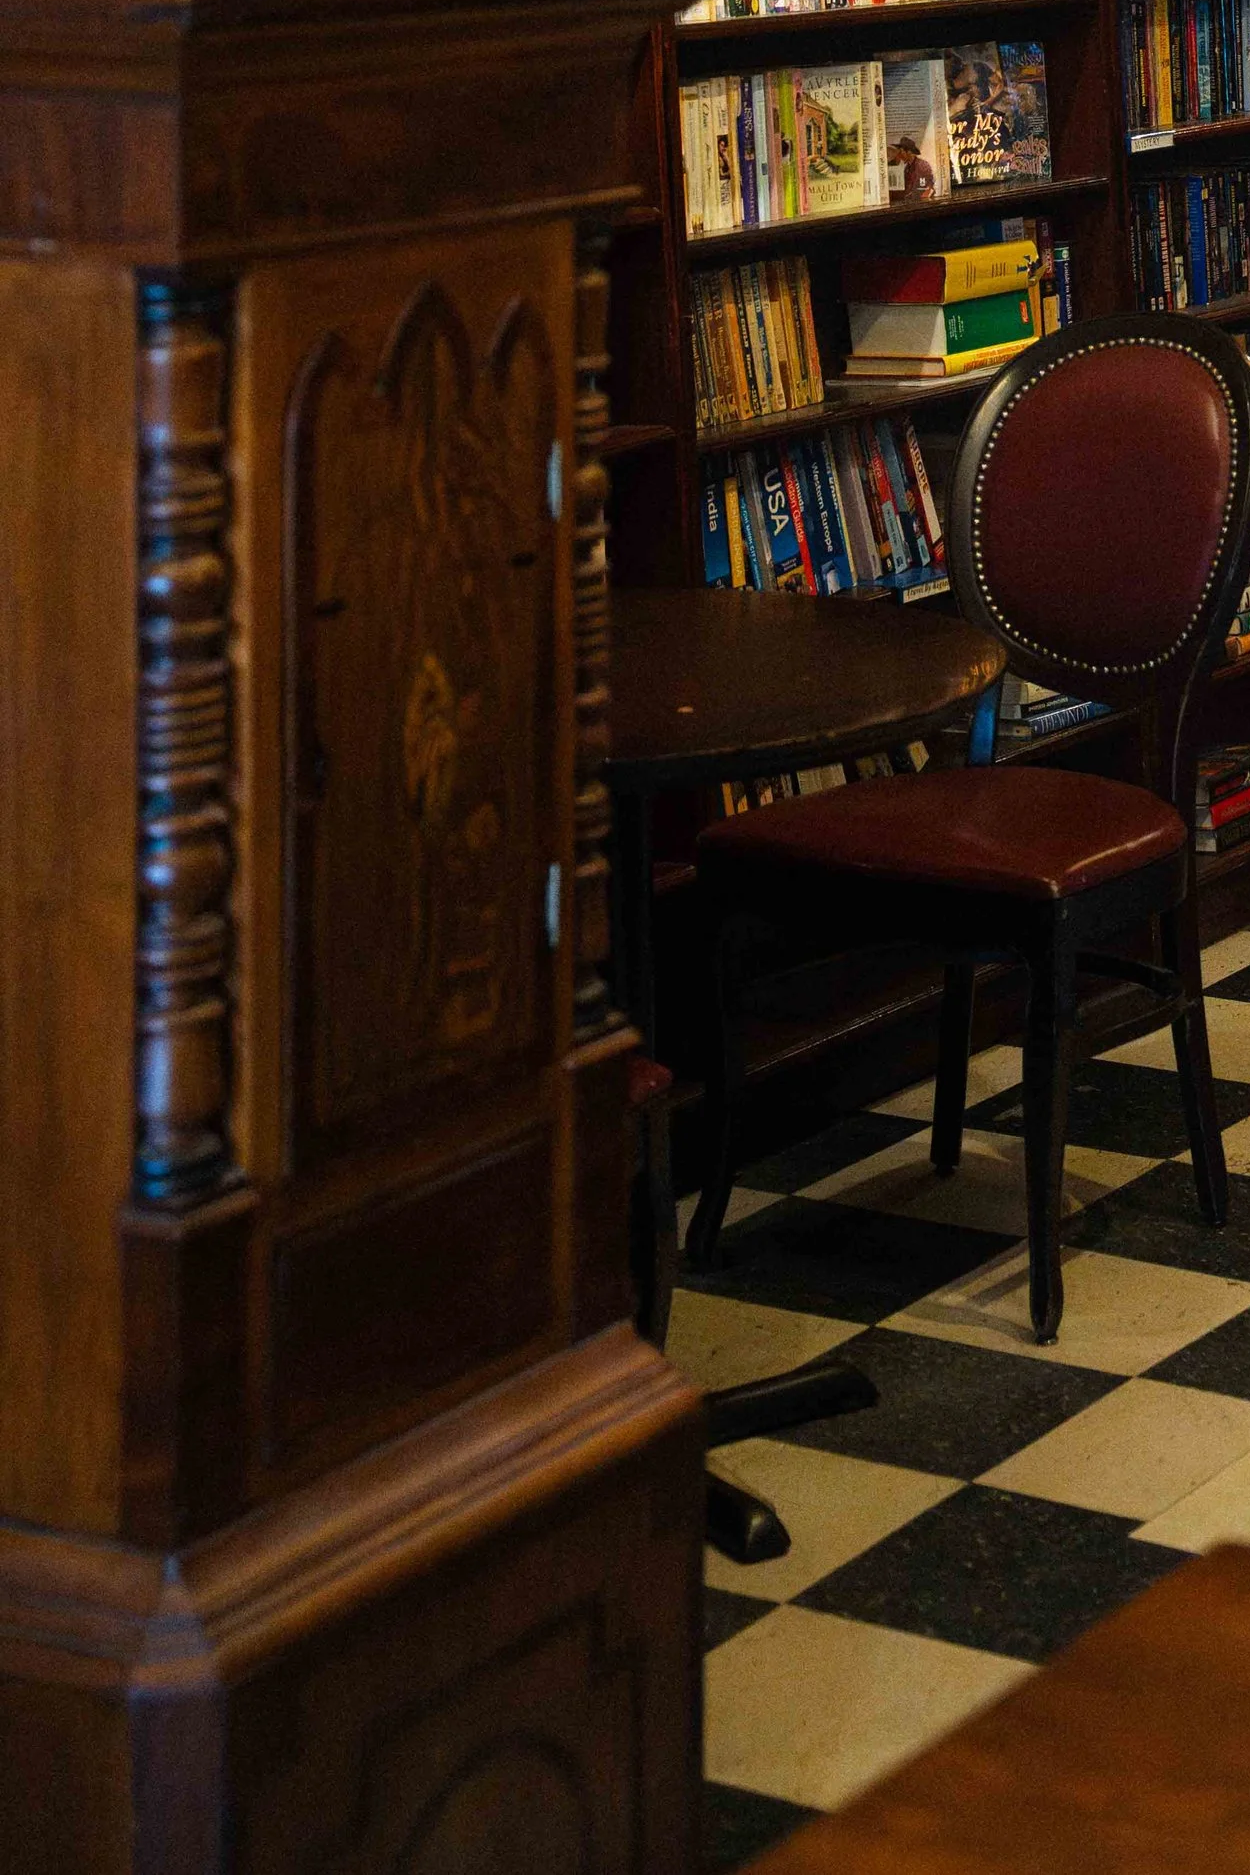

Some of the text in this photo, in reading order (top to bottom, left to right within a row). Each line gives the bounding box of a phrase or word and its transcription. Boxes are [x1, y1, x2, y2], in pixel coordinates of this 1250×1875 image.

[974, 112, 1003, 137] My
[967, 163, 1010, 178] Howard
[835, 180, 863, 190] TOWN
[820, 192, 844, 203] GIRL
[907, 429, 930, 495] EUROPE
[704, 483, 718, 533] India
[763, 466, 792, 537] USA
[811, 461, 834, 553] Western Europe
[750, 545, 758, 563] CITY
[924, 583, 932, 592] by
